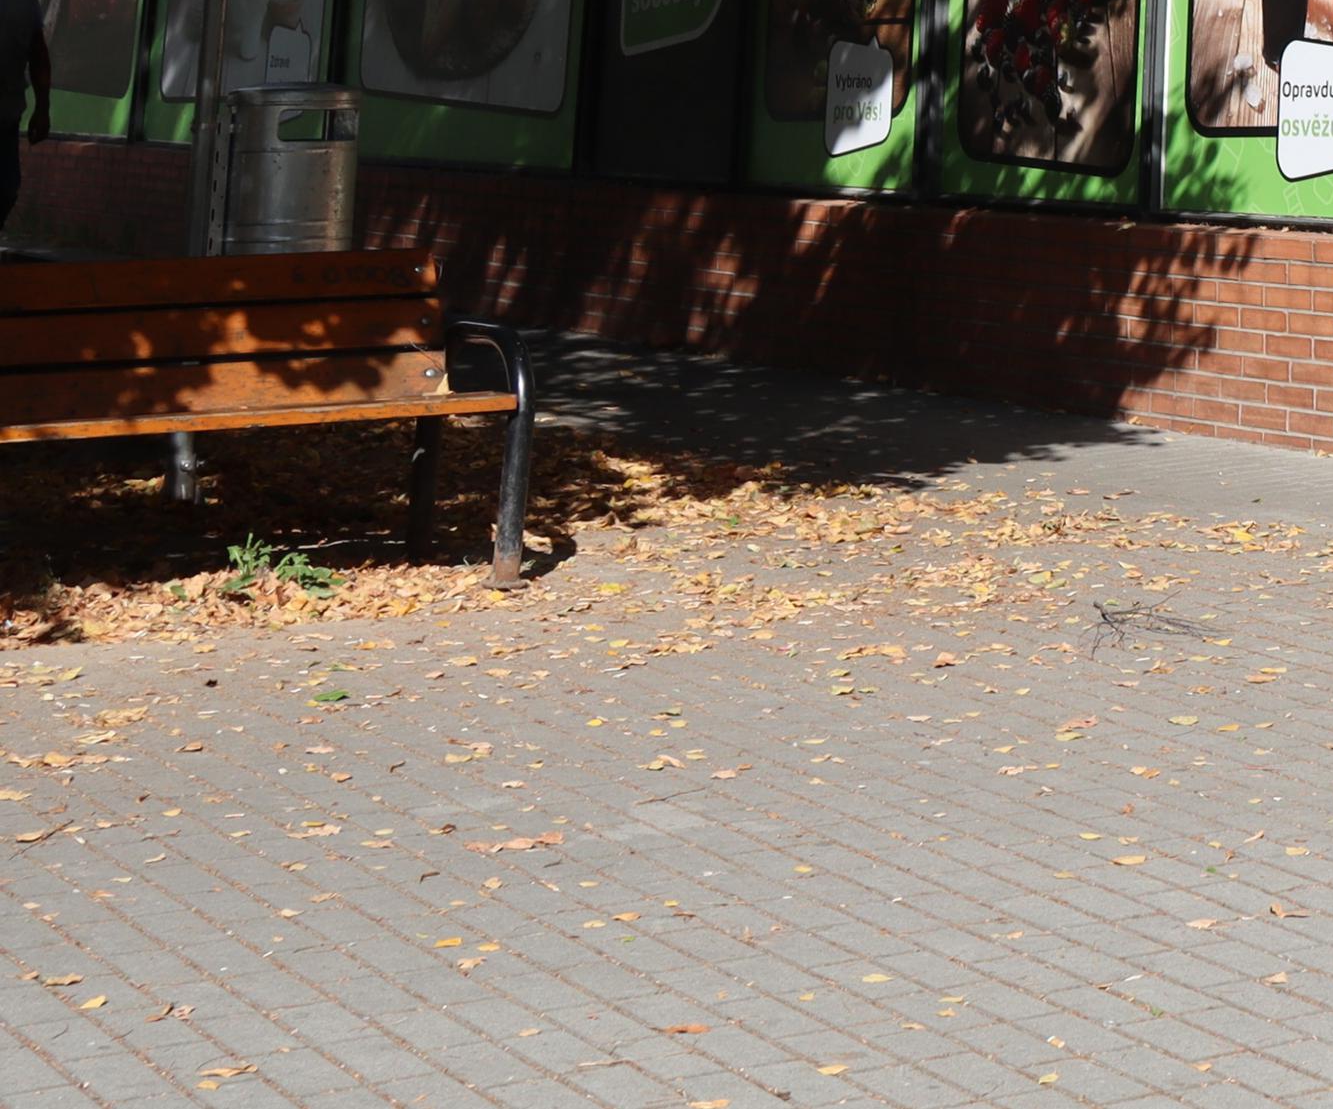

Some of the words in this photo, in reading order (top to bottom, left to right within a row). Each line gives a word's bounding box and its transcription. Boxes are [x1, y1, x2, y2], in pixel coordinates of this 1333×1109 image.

[835, 73, 873, 92] Vybráno
[833, 104, 854, 125] pro
[857, 101, 883, 122] Vás!
